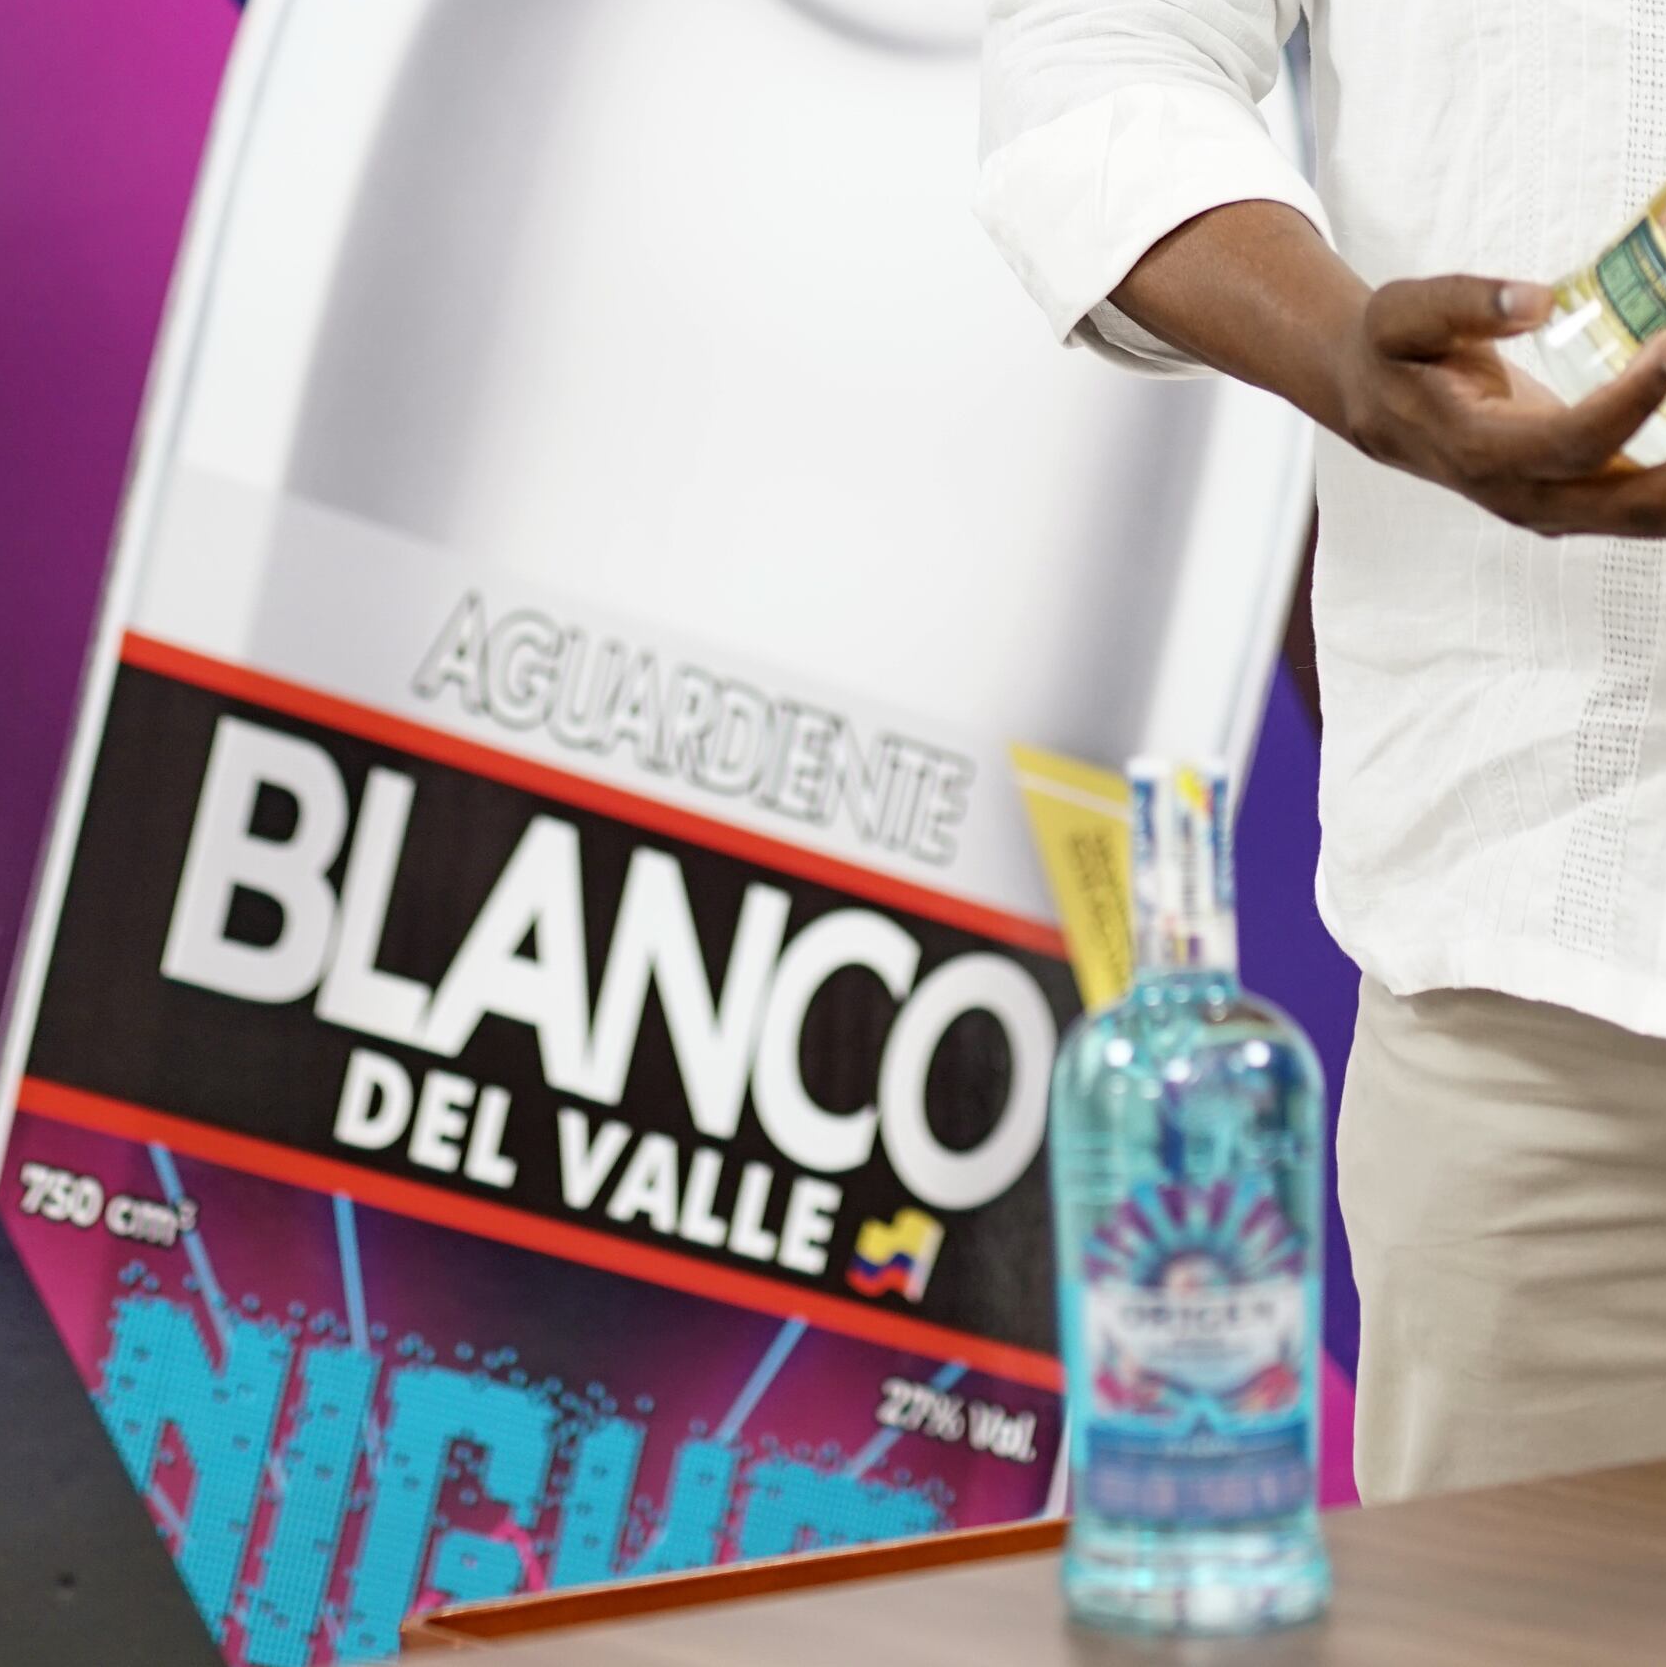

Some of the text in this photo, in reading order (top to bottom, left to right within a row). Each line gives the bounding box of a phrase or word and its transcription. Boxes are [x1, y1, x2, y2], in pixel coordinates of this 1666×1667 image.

[415, 590, 978, 868] AGUARDIENTE
[161, 714, 1059, 1211] BLANCO
[19, 1160, 105, 1229] 750
[334, 1047, 842, 1276] DEL VALLE
[875, 1377, 967, 1443] 27%
